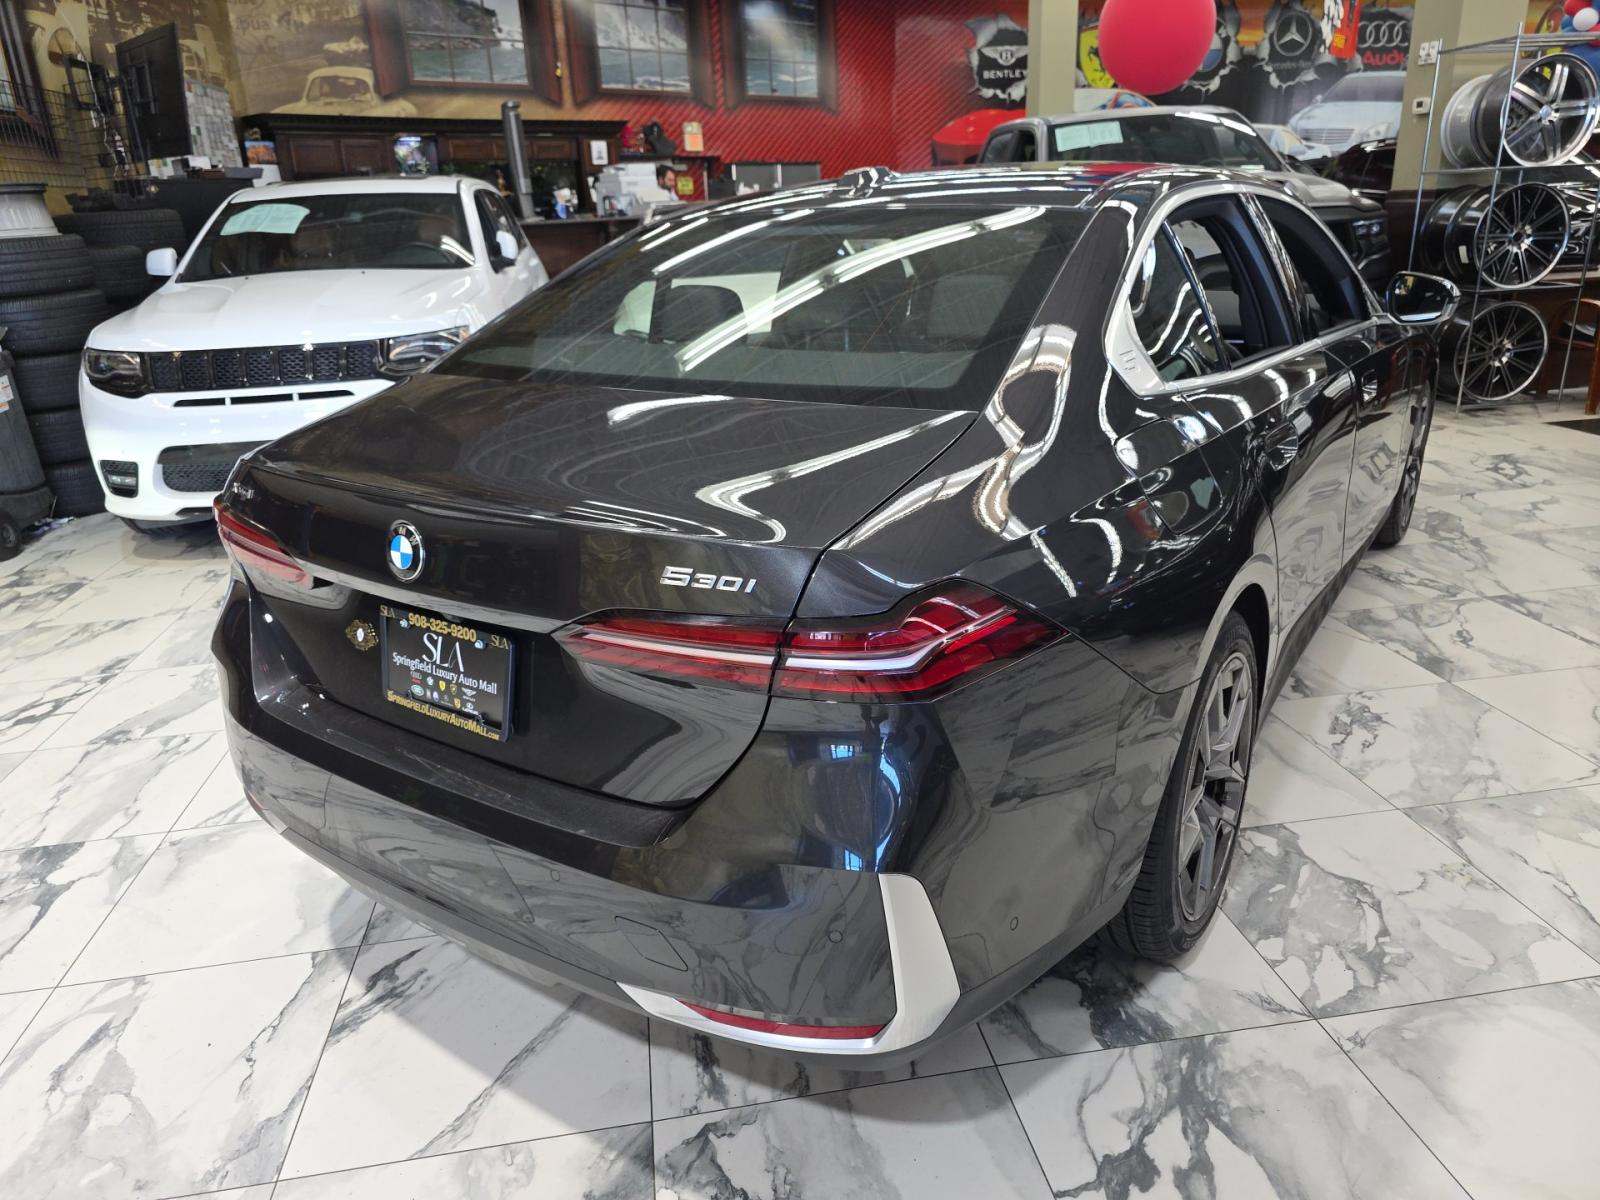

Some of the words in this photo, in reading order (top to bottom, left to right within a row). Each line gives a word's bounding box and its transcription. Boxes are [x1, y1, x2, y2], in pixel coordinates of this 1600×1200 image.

[982, 69, 1027, 79] BENTLEY
[408, 612, 477, 643] 908-325-9200
[490, 634, 509, 650] SLA
[422, 632, 465, 672] SLA
[392, 651, 432, 673] Springfield
[432, 664, 458, 683] Luxury
[458, 674, 478, 687] Auto
[479, 679, 498, 695] Mall
